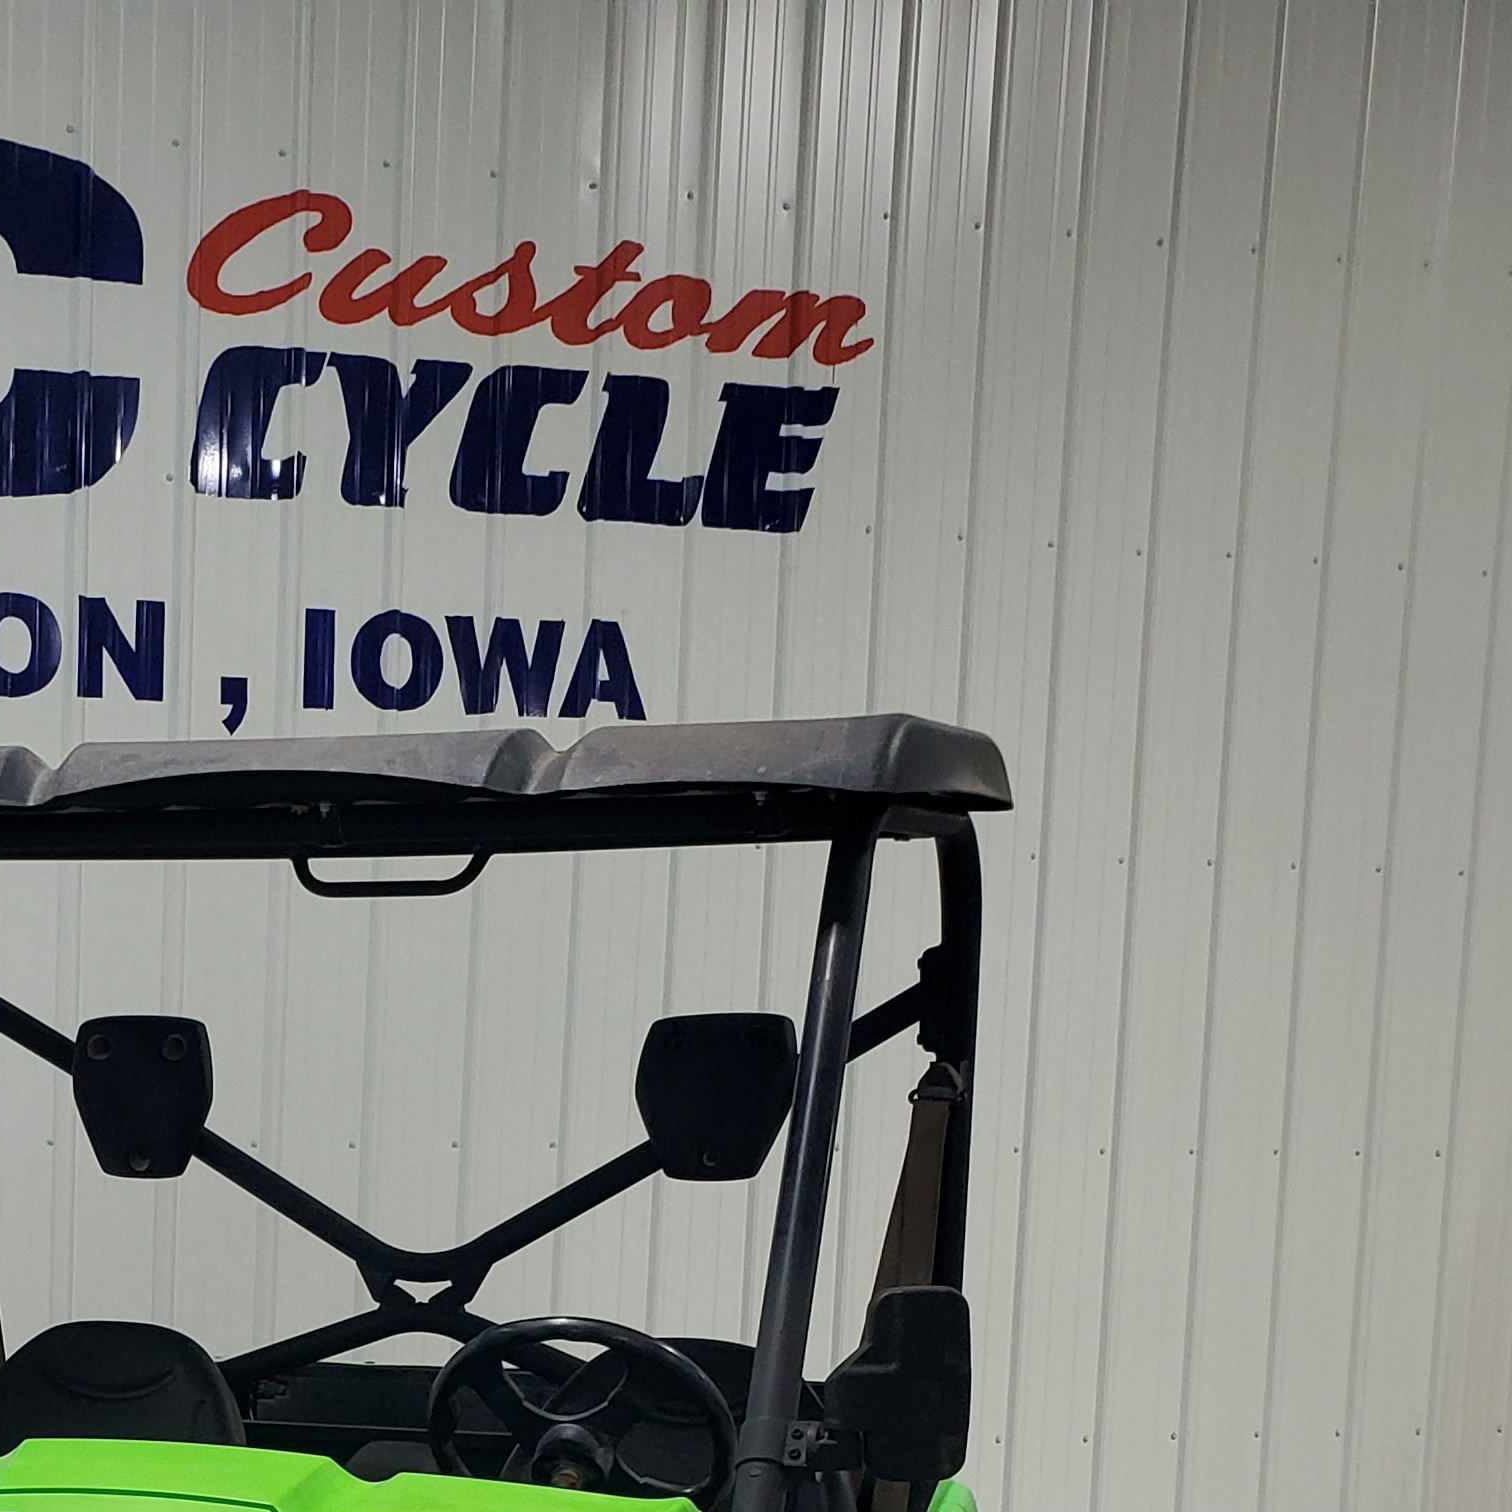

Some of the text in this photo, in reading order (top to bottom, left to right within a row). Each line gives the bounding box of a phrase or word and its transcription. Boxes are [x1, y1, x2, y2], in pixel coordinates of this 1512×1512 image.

[186, 189, 874, 365] Custom
[190, 346, 840, 533] CYCLE
[302, 609, 647, 721] IOWA
